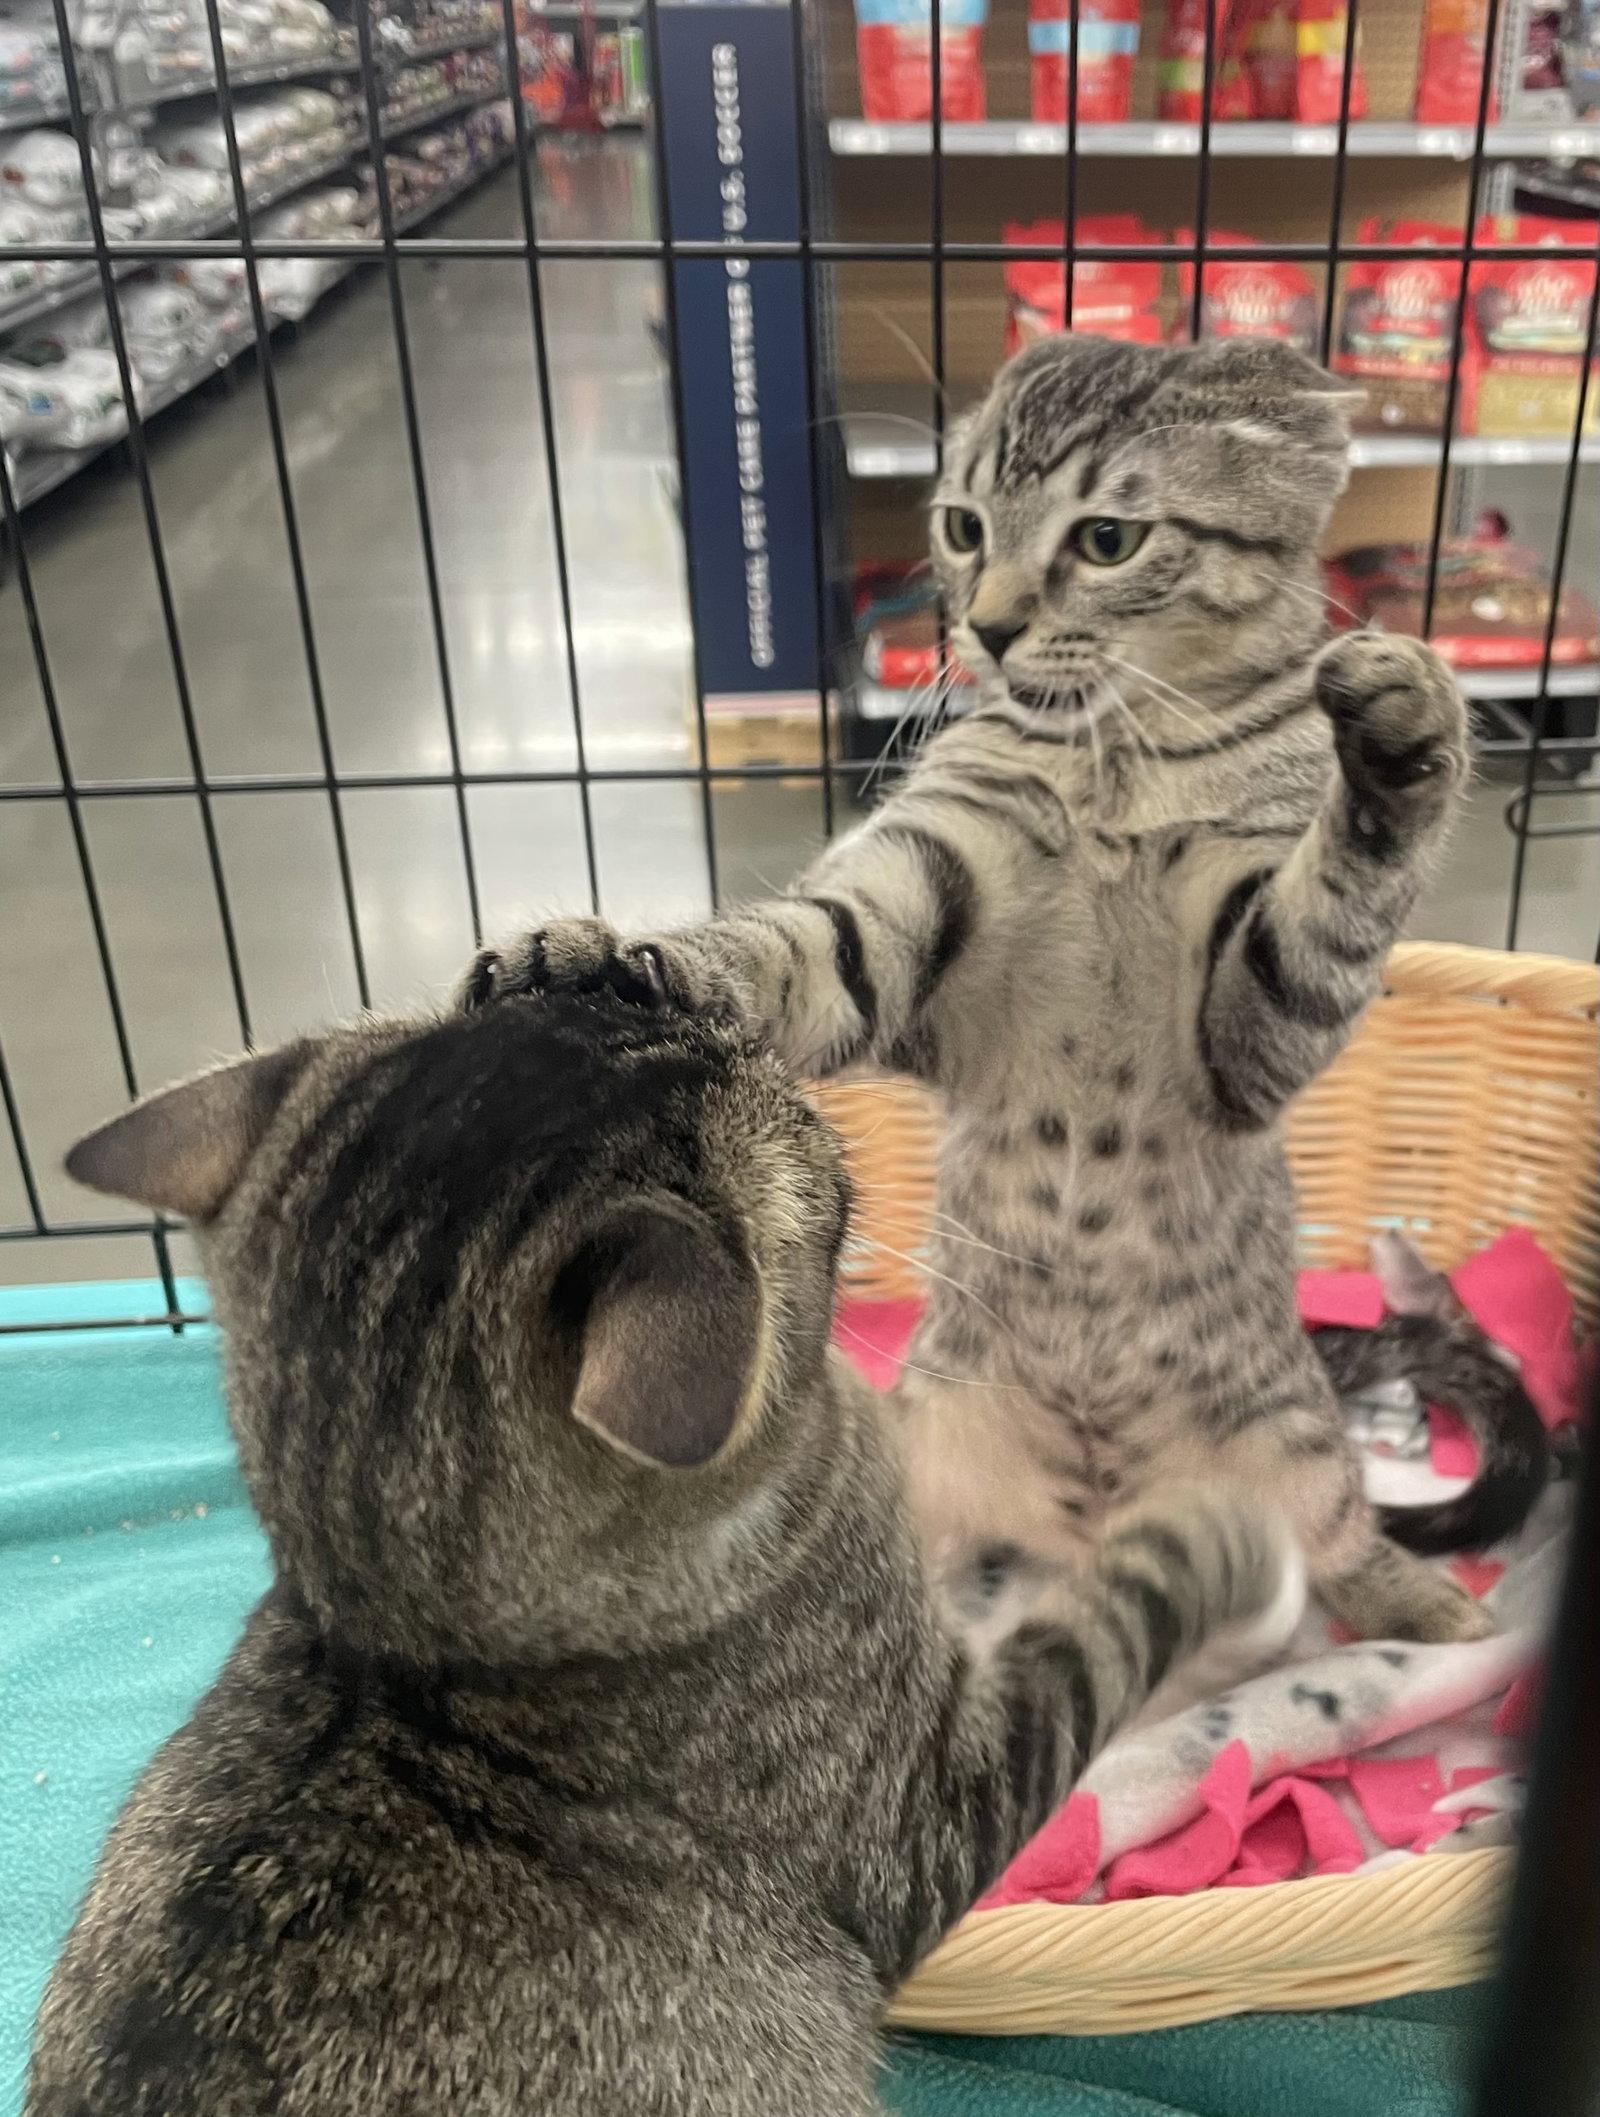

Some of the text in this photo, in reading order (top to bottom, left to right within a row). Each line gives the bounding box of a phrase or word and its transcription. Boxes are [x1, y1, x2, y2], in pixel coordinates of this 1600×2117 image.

[711, 42, 743, 164] SOCCER
[727, 281, 757, 415] PARTNER
[736, 419, 763, 491] CARE
[740, 496, 766, 549] PET
[746, 555, 774, 668] OFFICIAL
